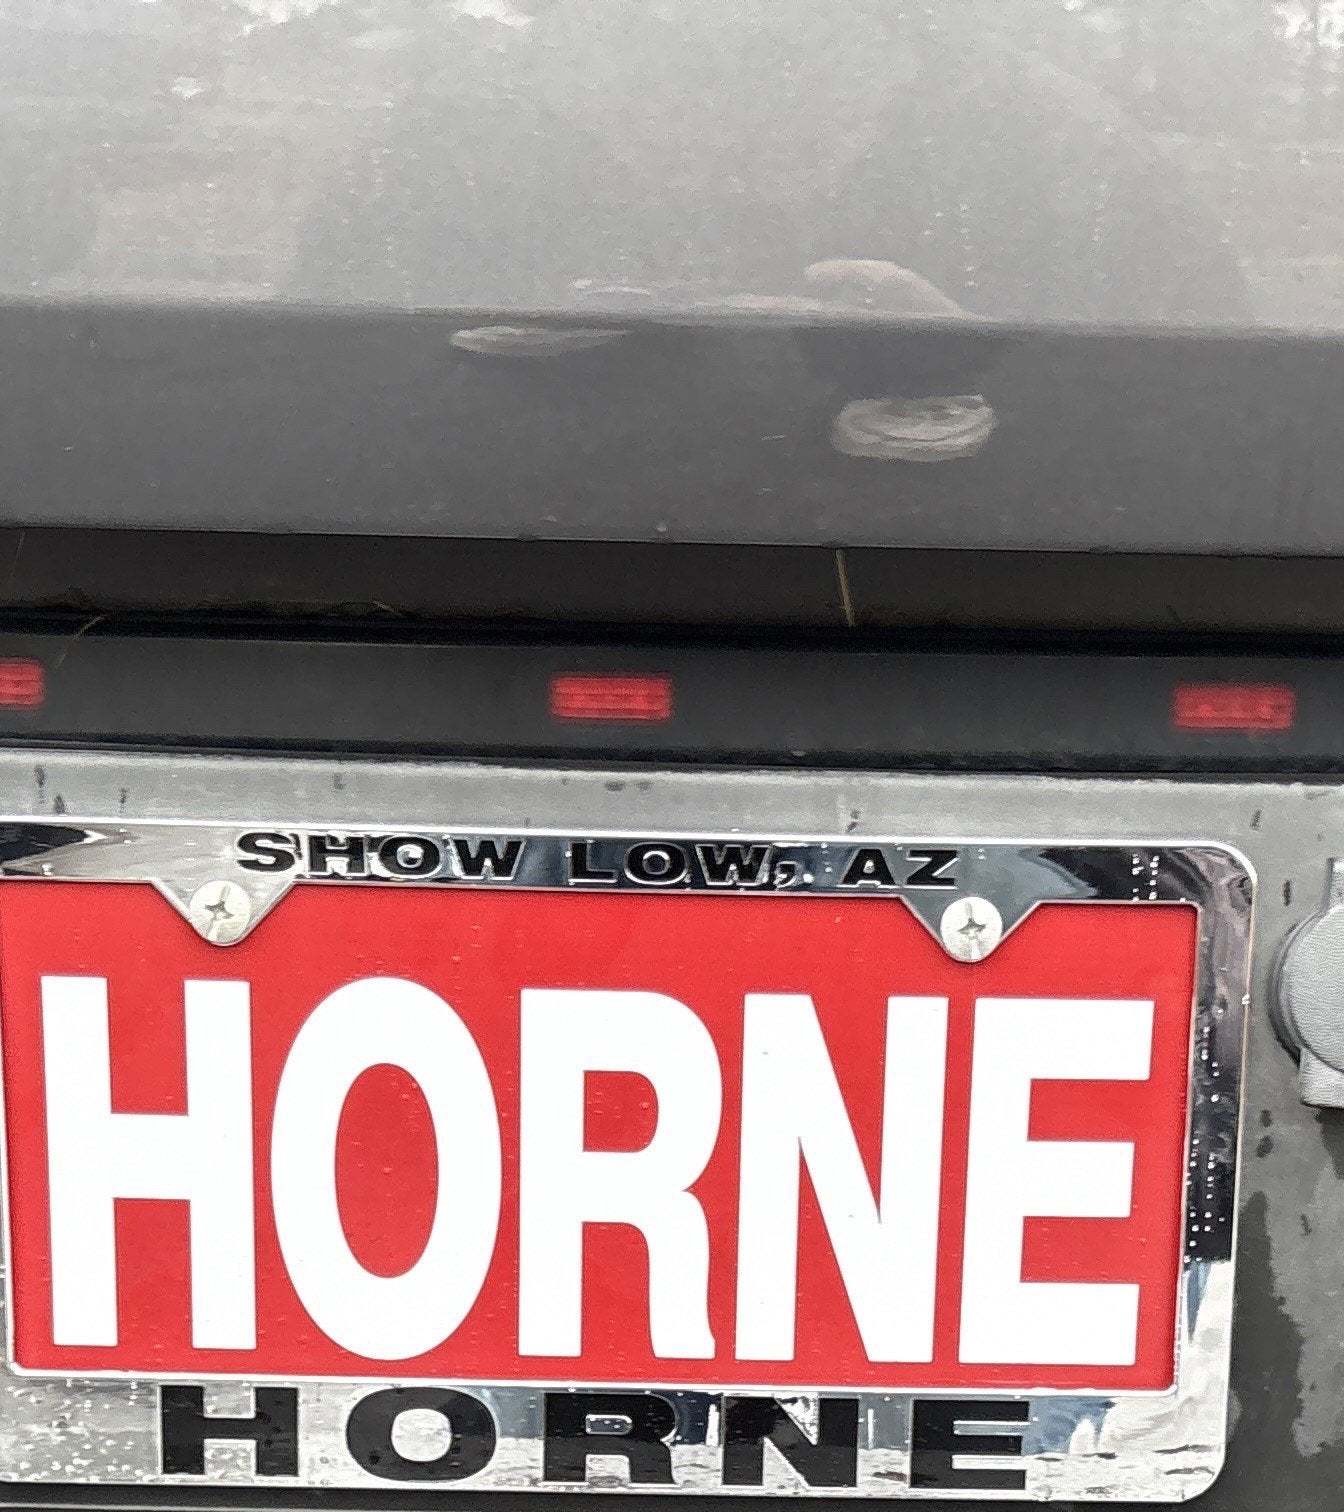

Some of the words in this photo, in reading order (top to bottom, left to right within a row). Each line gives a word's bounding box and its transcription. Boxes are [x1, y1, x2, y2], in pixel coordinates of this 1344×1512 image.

[236, 832, 526, 880] SHOW
[568, 841, 806, 888] LOW,
[838, 847, 958, 890] AZ
[40, 976, 1156, 1366] HORNE
[159, 1383, 1032, 1491] HORNE
